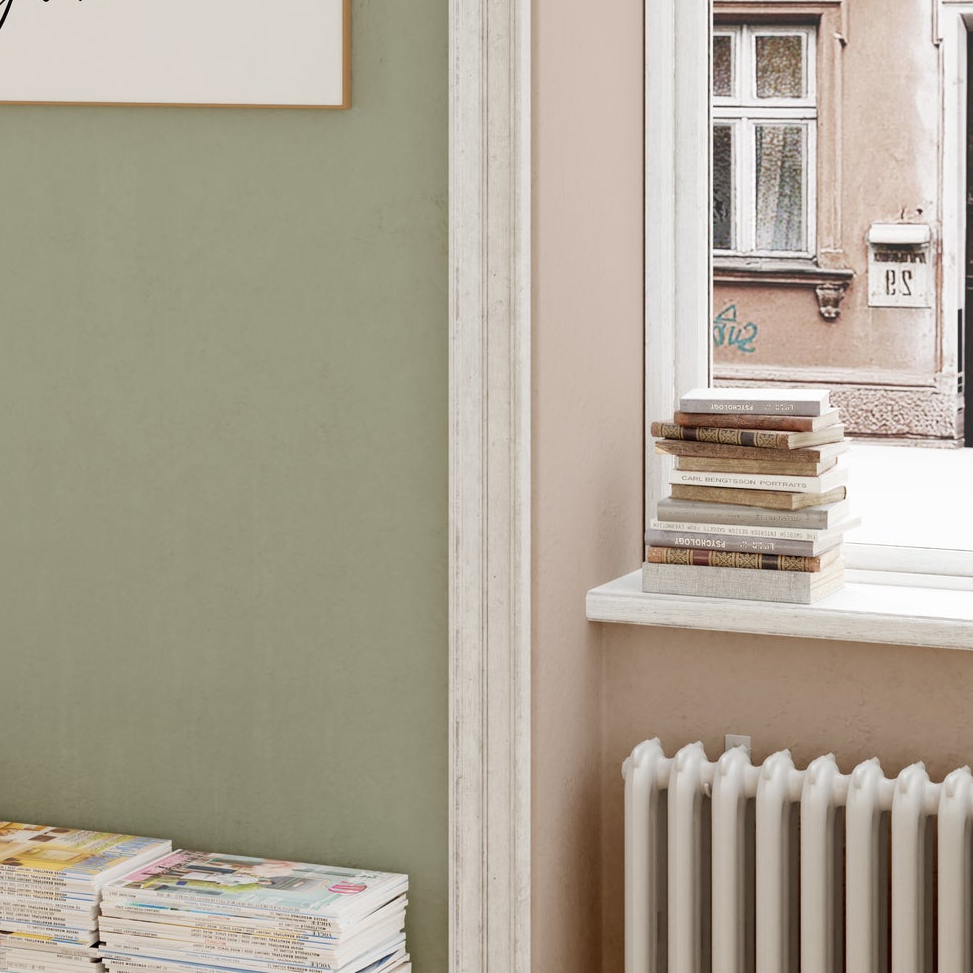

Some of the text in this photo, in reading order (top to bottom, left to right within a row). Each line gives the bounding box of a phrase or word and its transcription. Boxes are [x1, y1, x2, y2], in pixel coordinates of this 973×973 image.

[704, 477, 756, 485] BENGTSSON
[759, 480, 807, 489] PORTRAITS
[674, 537, 726, 548] PSYCHOLOGY
